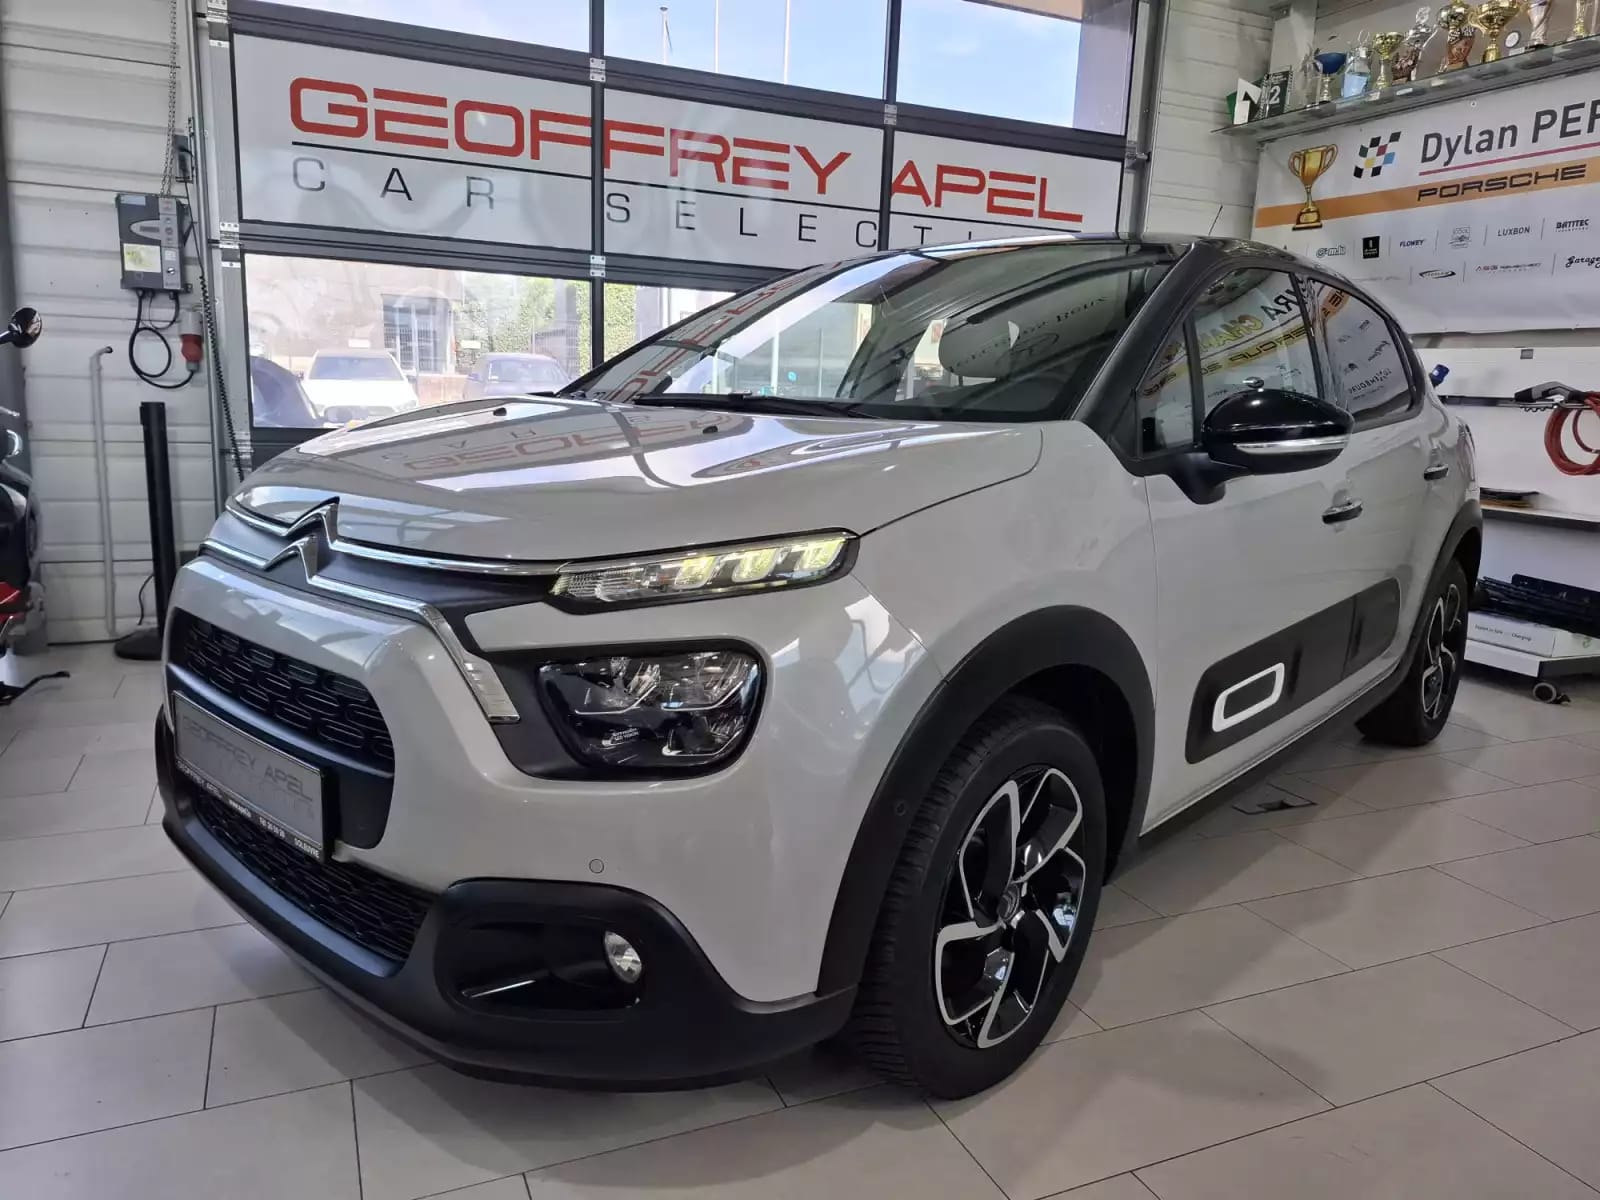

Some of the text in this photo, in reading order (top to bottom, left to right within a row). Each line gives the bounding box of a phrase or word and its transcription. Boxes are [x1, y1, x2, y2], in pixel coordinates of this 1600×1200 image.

[290, 77, 1083, 223] GEOFFREY APEL
[1421, 124, 1518, 166] Dylan
[292, 156, 495, 210] CAR
[1417, 163, 1587, 202] PORSCHE
[1497, 226, 1531, 237] LUXBON
